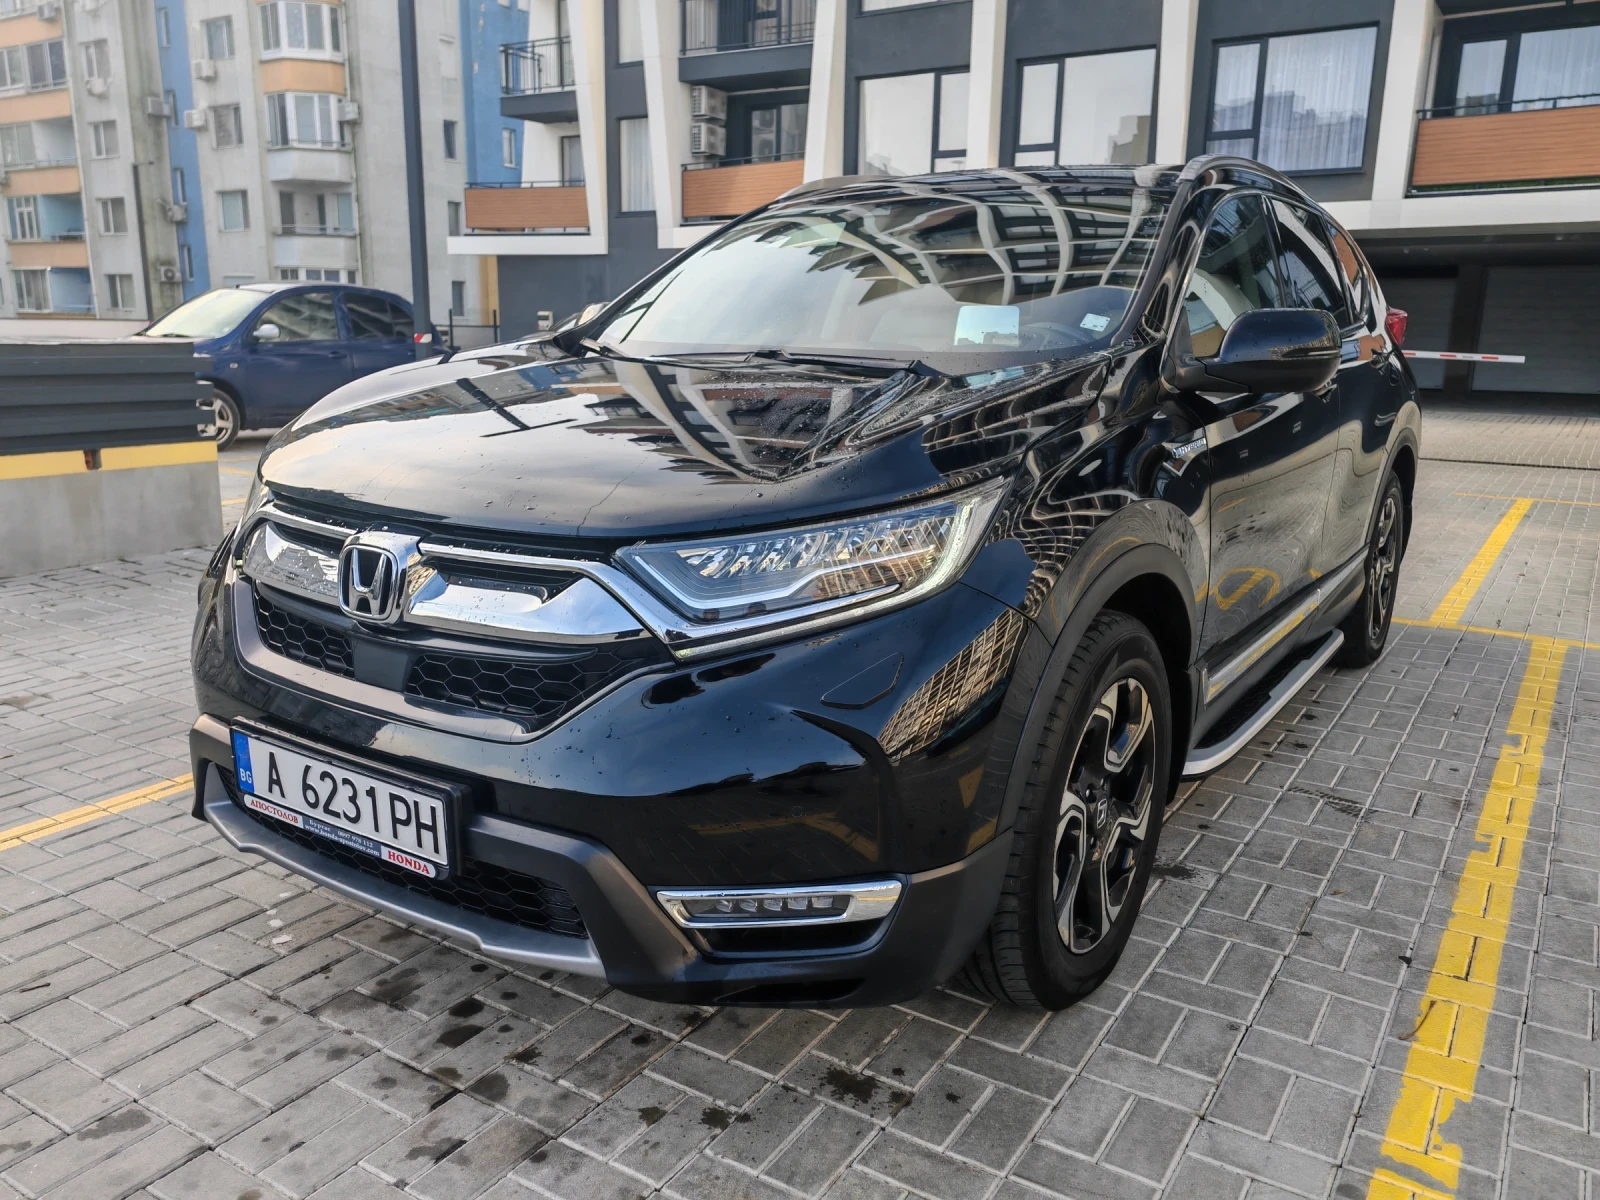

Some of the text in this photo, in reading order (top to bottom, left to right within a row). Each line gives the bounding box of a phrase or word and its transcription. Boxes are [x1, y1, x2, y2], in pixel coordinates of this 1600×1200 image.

[239, 768, 252, 784] BG
[250, 799, 299, 824] АПОСТОЛОВ
[267, 751, 440, 855] A 6231 PH
[304, 824, 380, 857] www.honda-apostolov.com
[387, 850, 430, 875] HONDA
